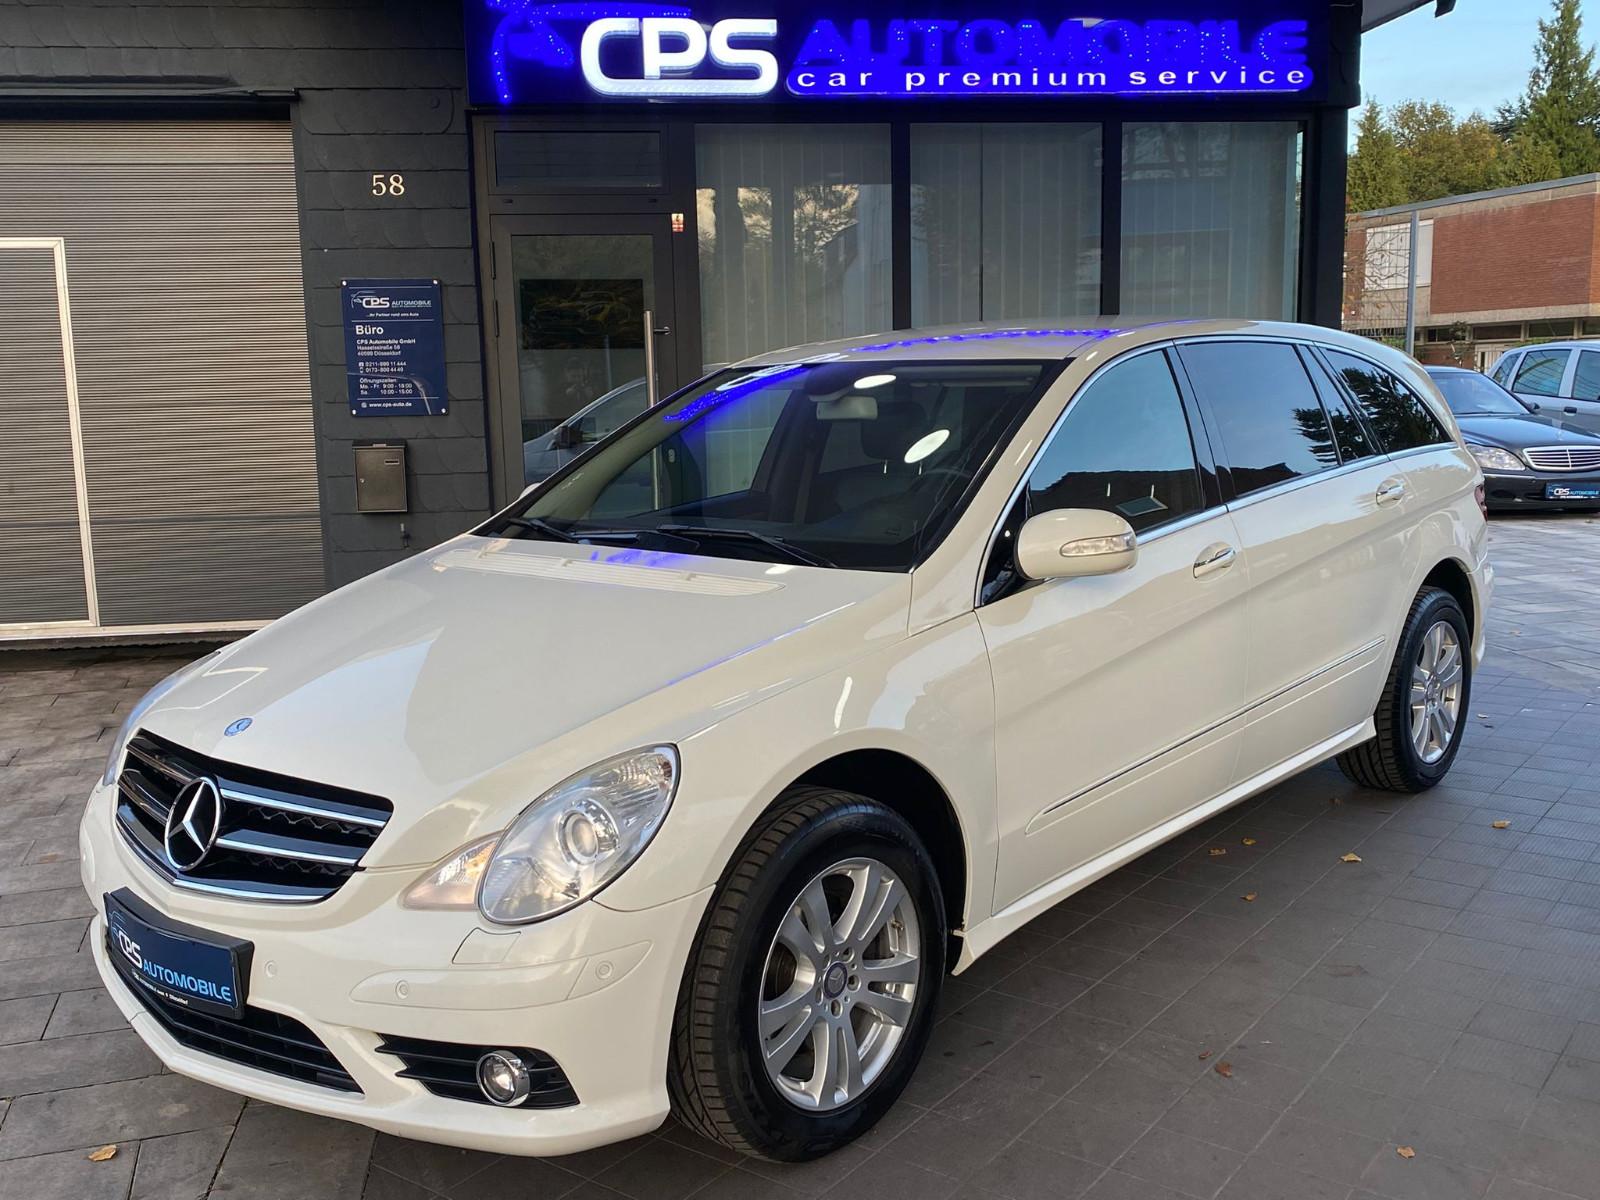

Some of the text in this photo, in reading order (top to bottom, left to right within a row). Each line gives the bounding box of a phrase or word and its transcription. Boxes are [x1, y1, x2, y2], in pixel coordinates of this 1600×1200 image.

[581, 18, 1307, 97] CPS AUTOMOBILE
[797, 66, 1304, 91] car premium service
[372, 174, 405, 196] 58
[362, 297, 390, 309] CPS
[355, 324, 384, 335] Büro
[118, 929, 143, 969] CPS
[143, 958, 232, 1003] AUTOMOBILE
